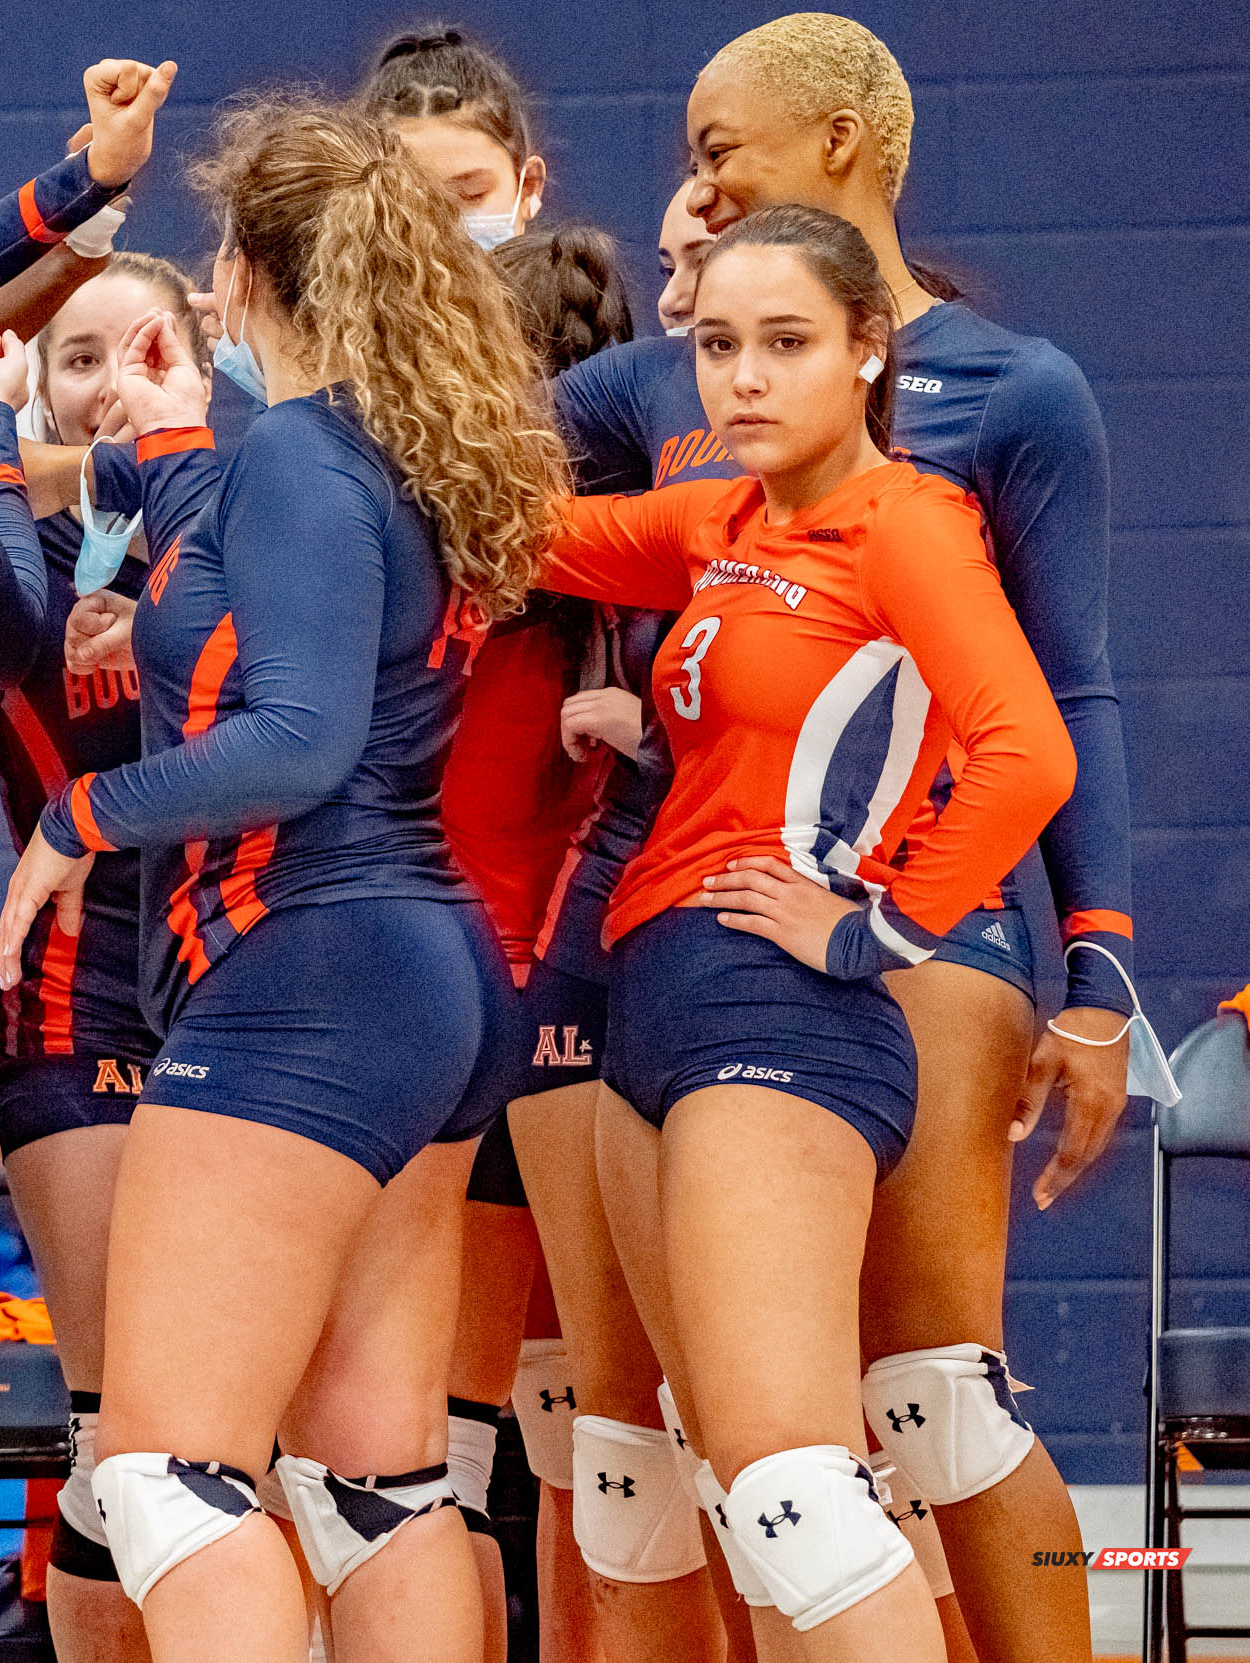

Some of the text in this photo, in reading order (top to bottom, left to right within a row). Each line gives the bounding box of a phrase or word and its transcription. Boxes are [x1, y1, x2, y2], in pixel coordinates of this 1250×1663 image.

[669, 616, 722, 721] 3
[532, 1025, 593, 1066] AL
[165, 1062, 210, 1079] asics
[741, 1065, 794, 1082] asics
